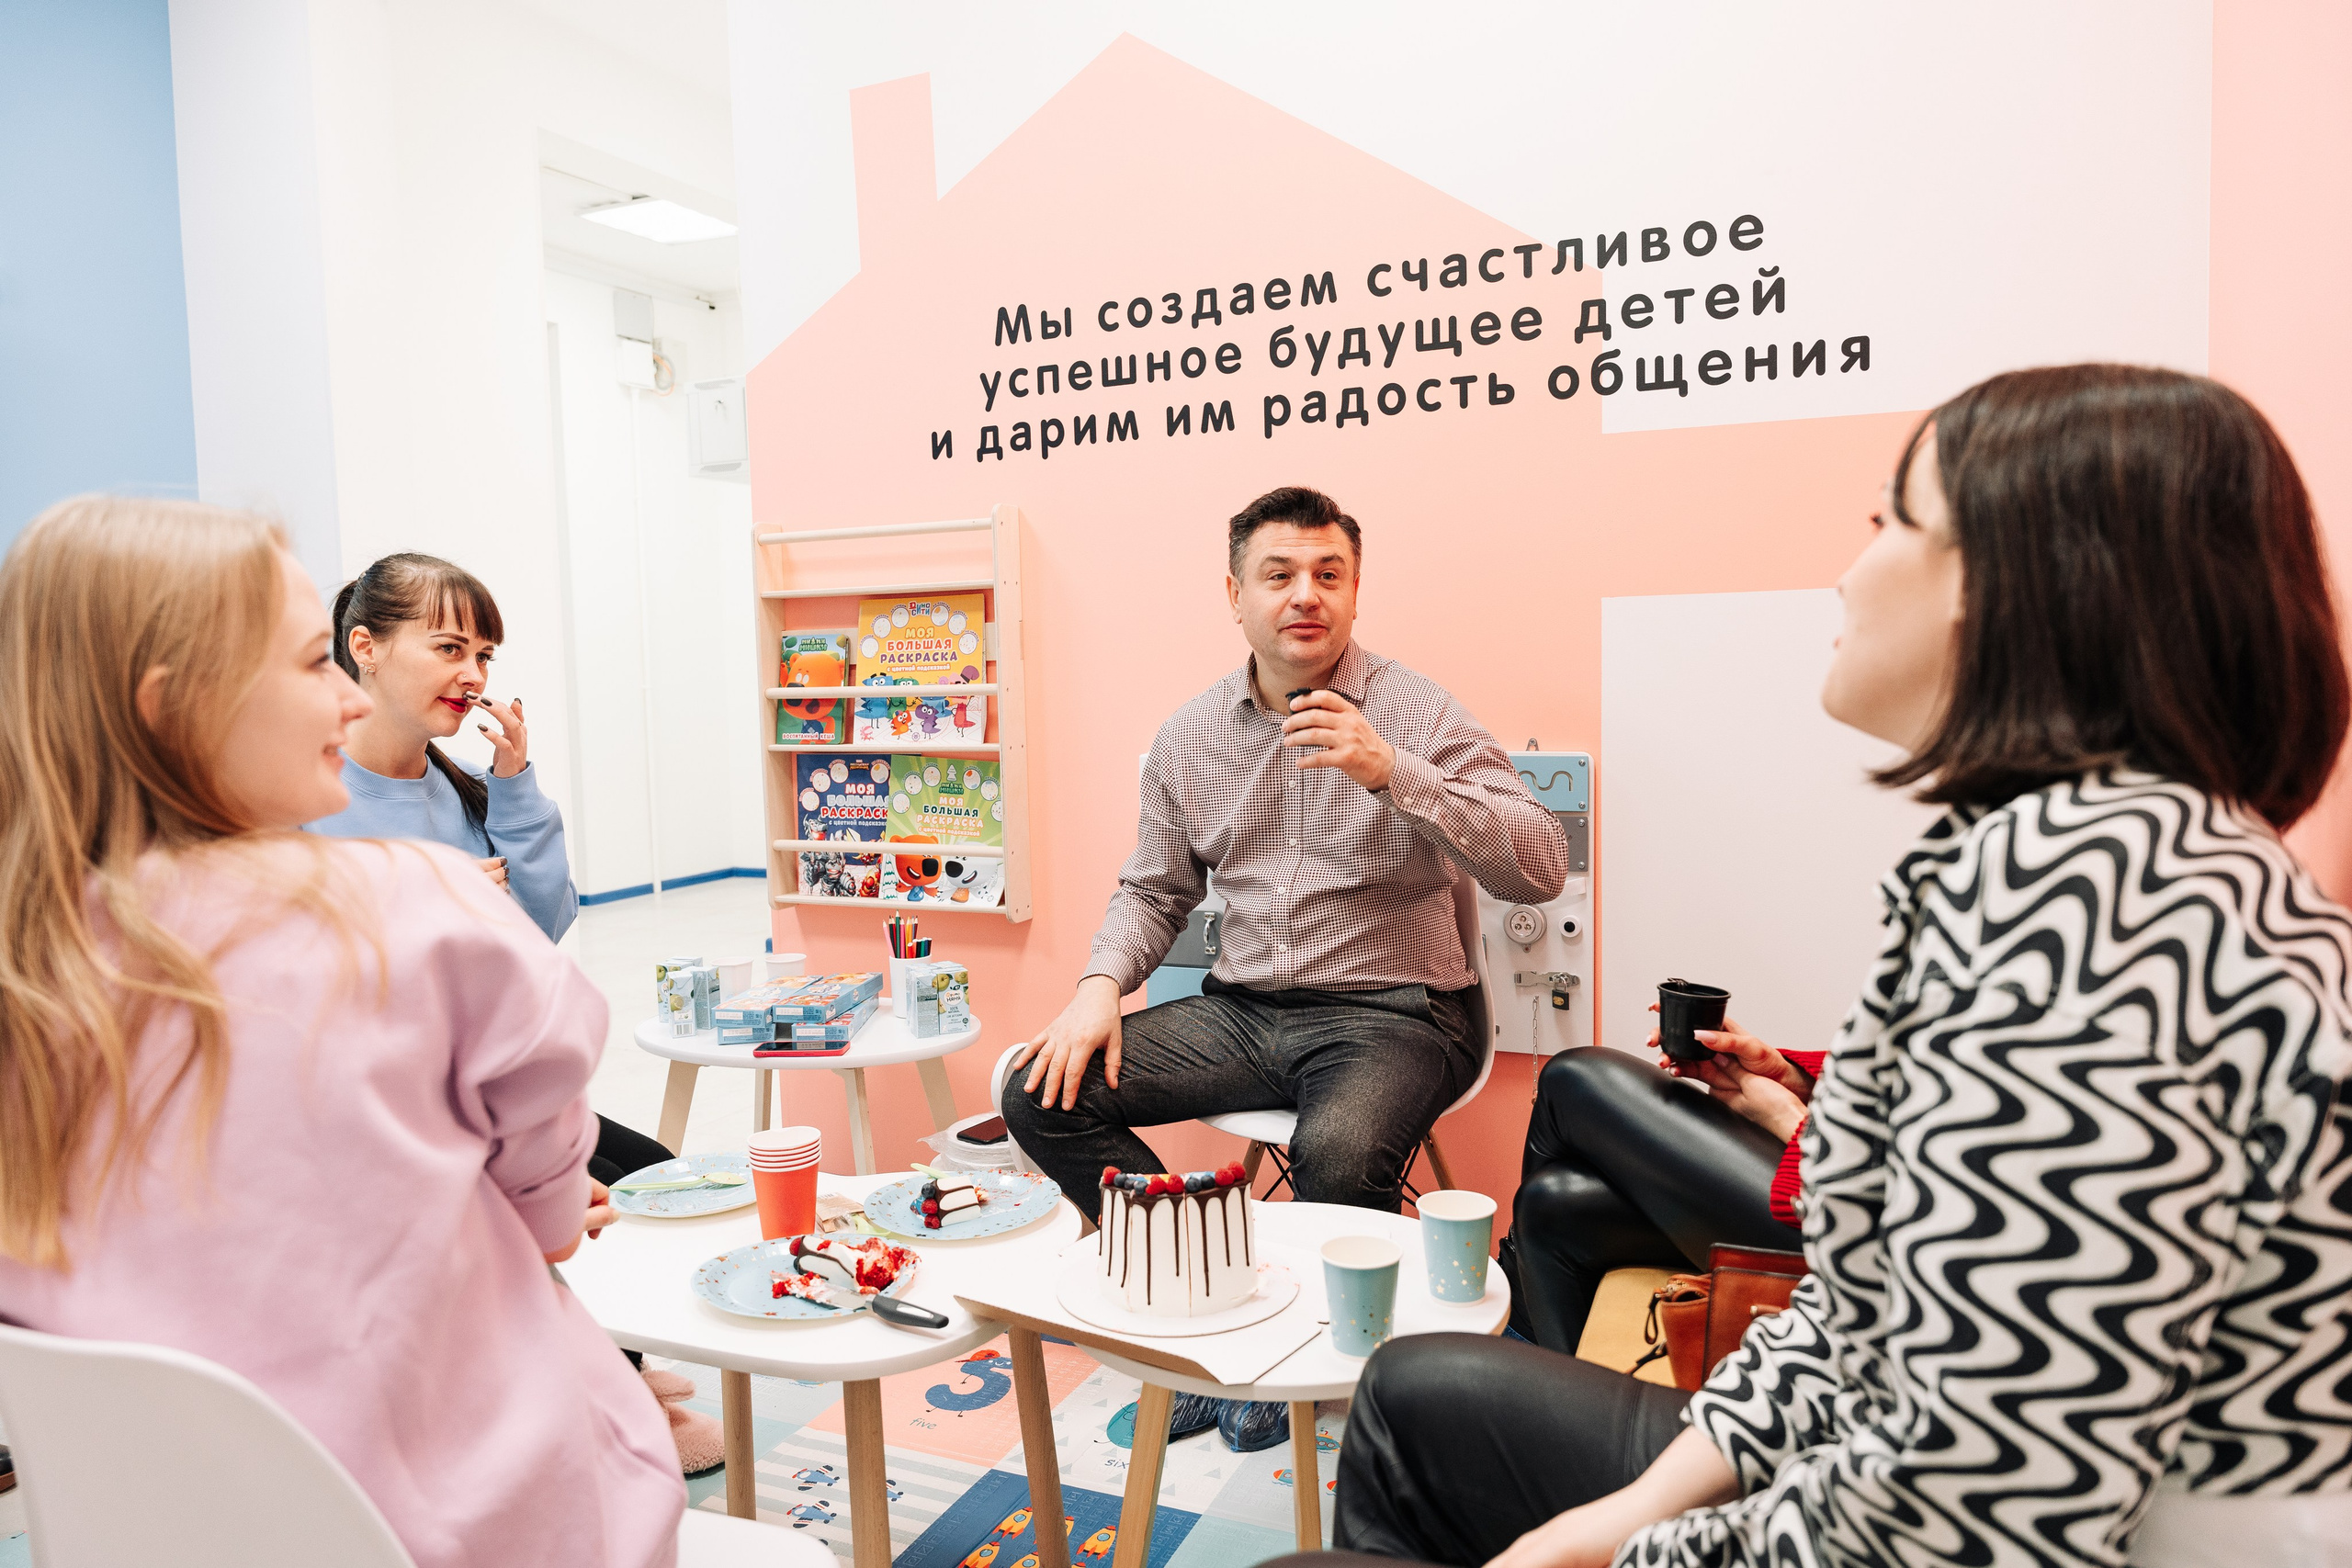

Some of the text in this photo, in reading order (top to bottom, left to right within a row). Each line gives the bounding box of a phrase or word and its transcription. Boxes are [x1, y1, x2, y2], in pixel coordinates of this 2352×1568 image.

[995, 214, 1764, 347] Мы создаем счастливое
[979, 265, 1785, 412] успешное будущее детей
[931, 335, 1871, 463] и дарим им радость общения
[905, 627, 934, 638] МОЯ
[887, 638, 952, 651] БОЛЬШАЯ
[880, 651, 958, 663] РАСКРАСКА
[844, 784, 875, 795] МОЯ
[938, 796, 964, 807] МОЯ
[821, 807, 888, 818] РАСКРАСК
[923, 805, 978, 818] БОЛЬШАЯ
[916, 814, 984, 829] РАСКРАСКА
[910, 1417, 937, 1430] five
[1104, 1459, 1130, 1470] six
